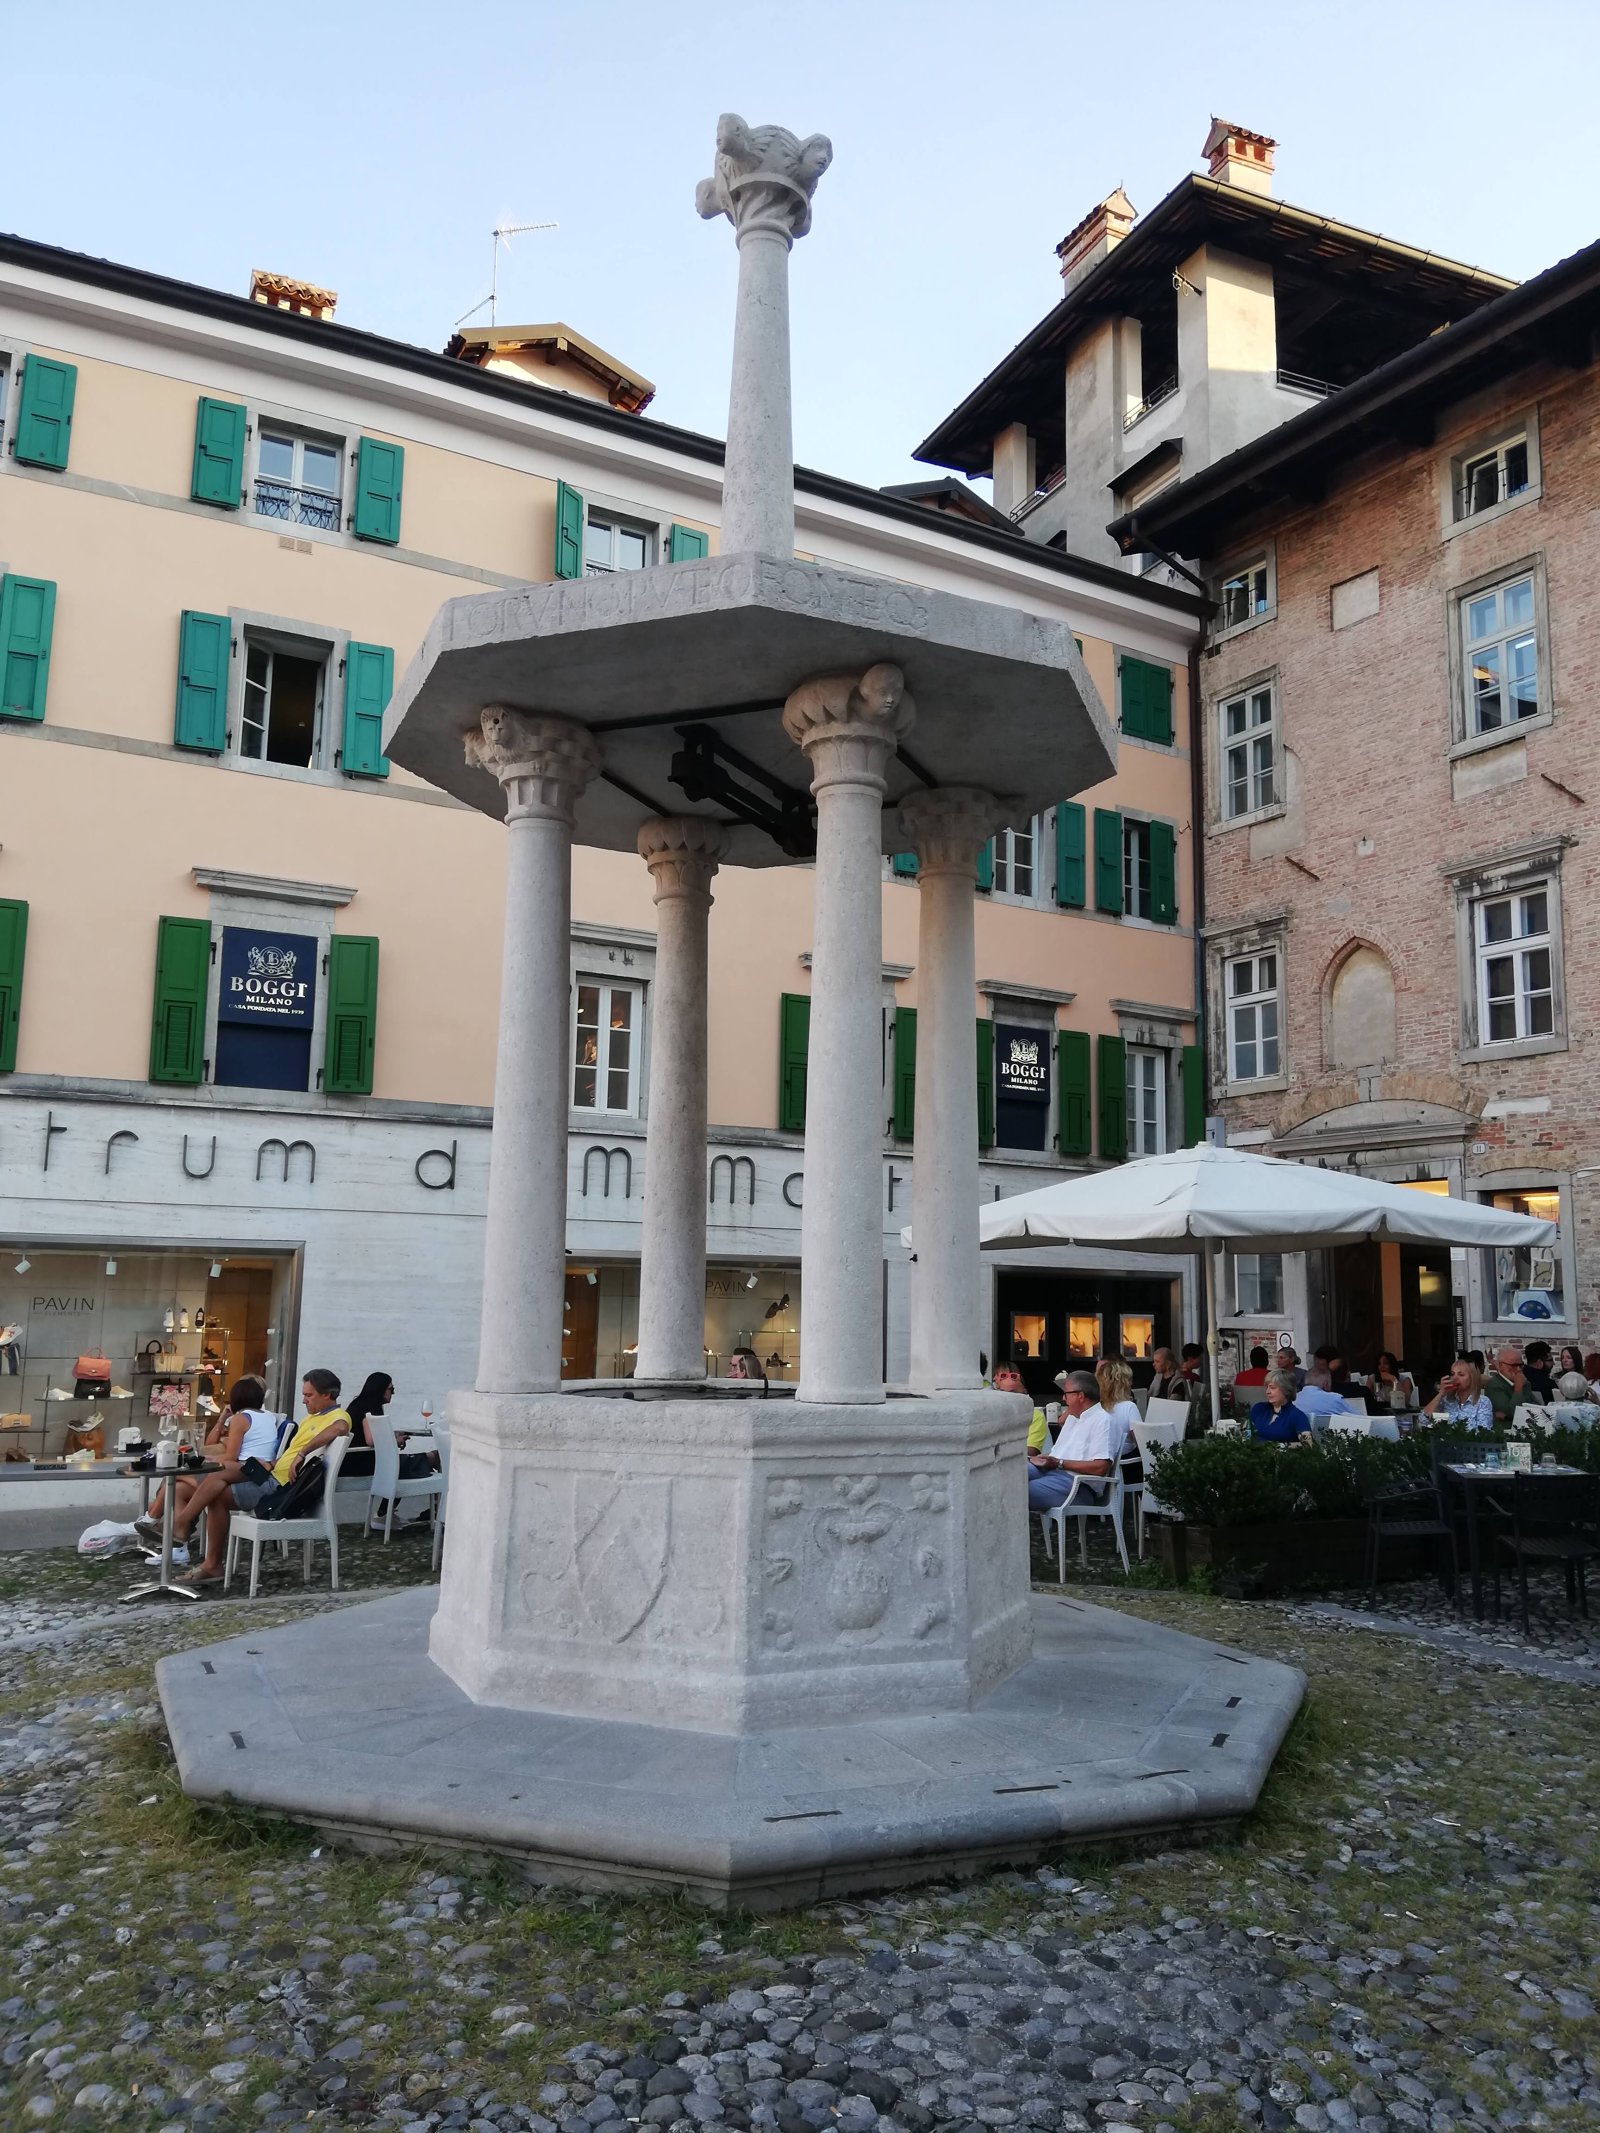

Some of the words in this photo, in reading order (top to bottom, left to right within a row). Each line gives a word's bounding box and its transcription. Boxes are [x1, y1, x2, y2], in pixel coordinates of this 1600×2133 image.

[230, 976, 308, 998] BOGGI
[245, 995, 293, 1006] MILANO
[1001, 1062, 1047, 1079] BOGGI
[1010, 1076, 1038, 1085] MILANO
[706, 1280, 746, 1293] PAVIN
[33, 1296, 95, 1311] PAVIN
